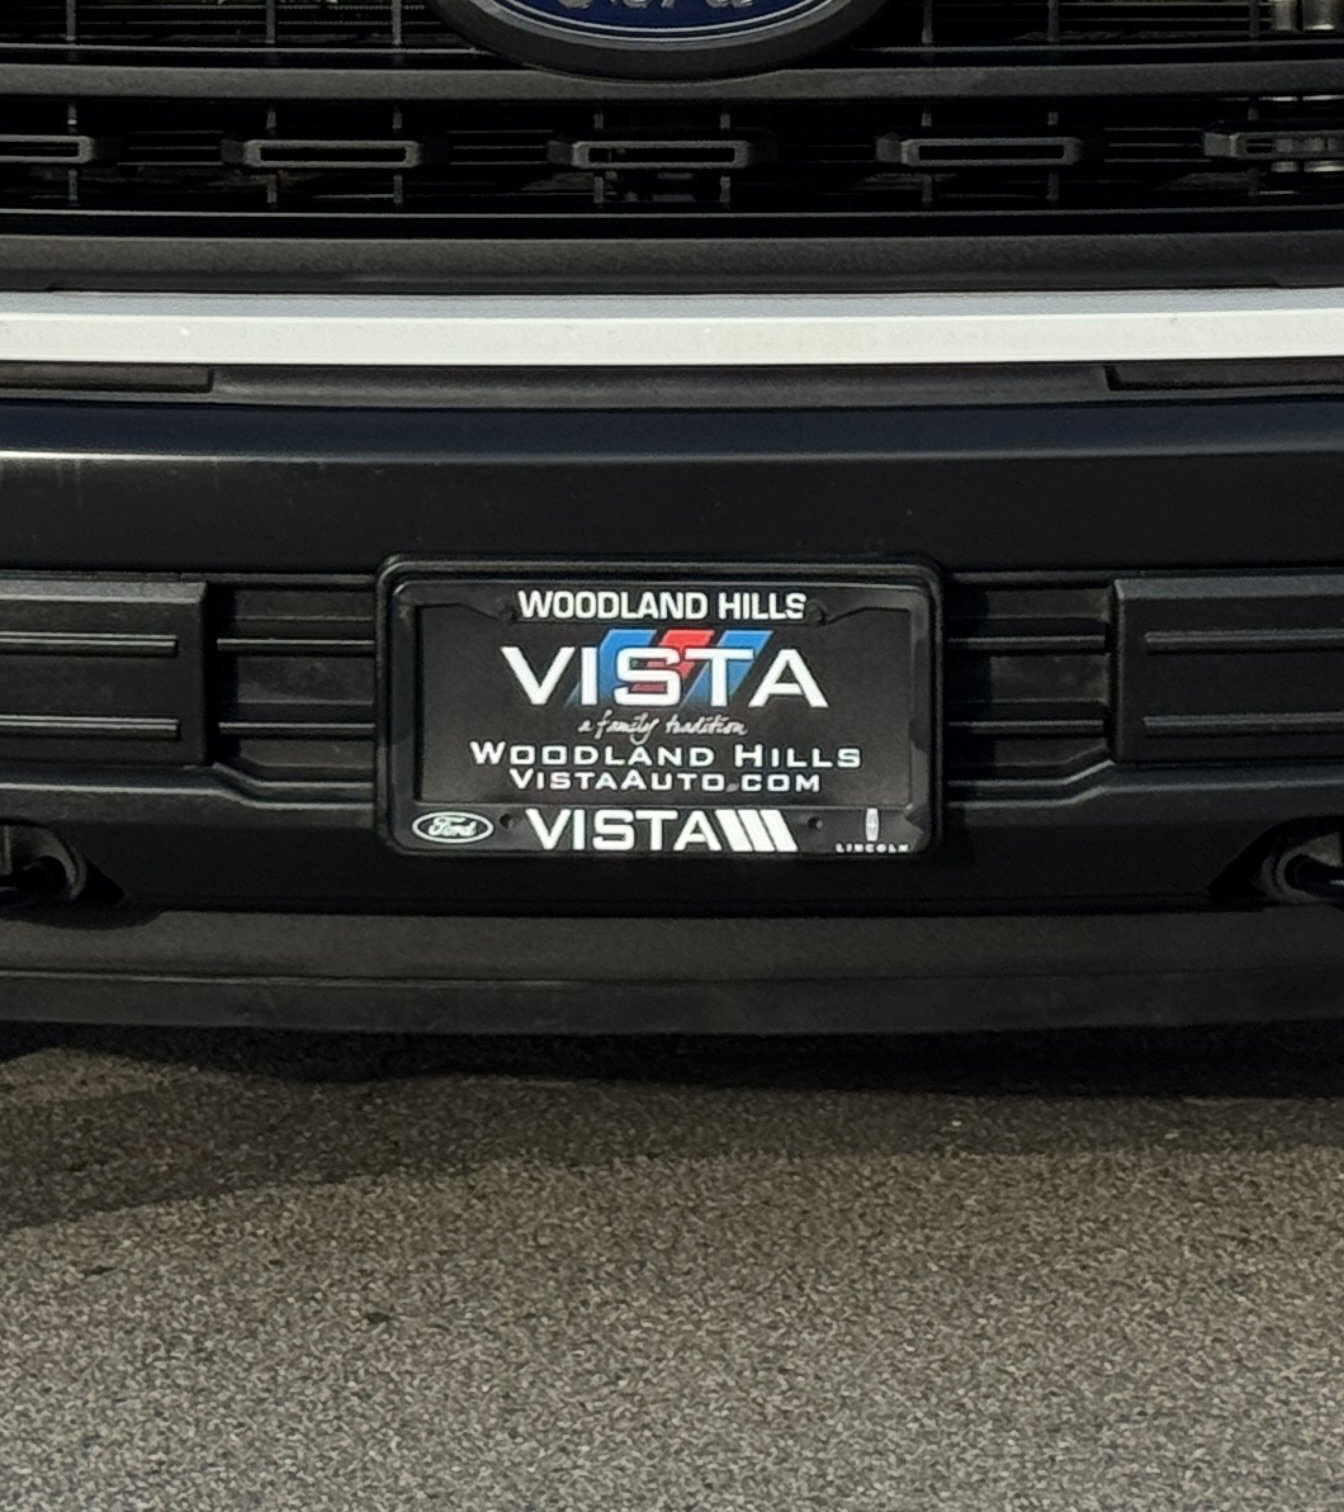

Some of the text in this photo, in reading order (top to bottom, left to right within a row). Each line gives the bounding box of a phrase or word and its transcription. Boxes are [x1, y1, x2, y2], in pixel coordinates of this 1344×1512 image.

[517, 590, 807, 620] WOODLAND HILLS
[500, 645, 829, 708] VISTA
[594, 708, 660, 746] family
[665, 713, 748, 736] tradition
[428, 816, 478, 837] Ford
[524, 808, 722, 852] VISTA
[835, 842, 909, 854] LINCOLN
